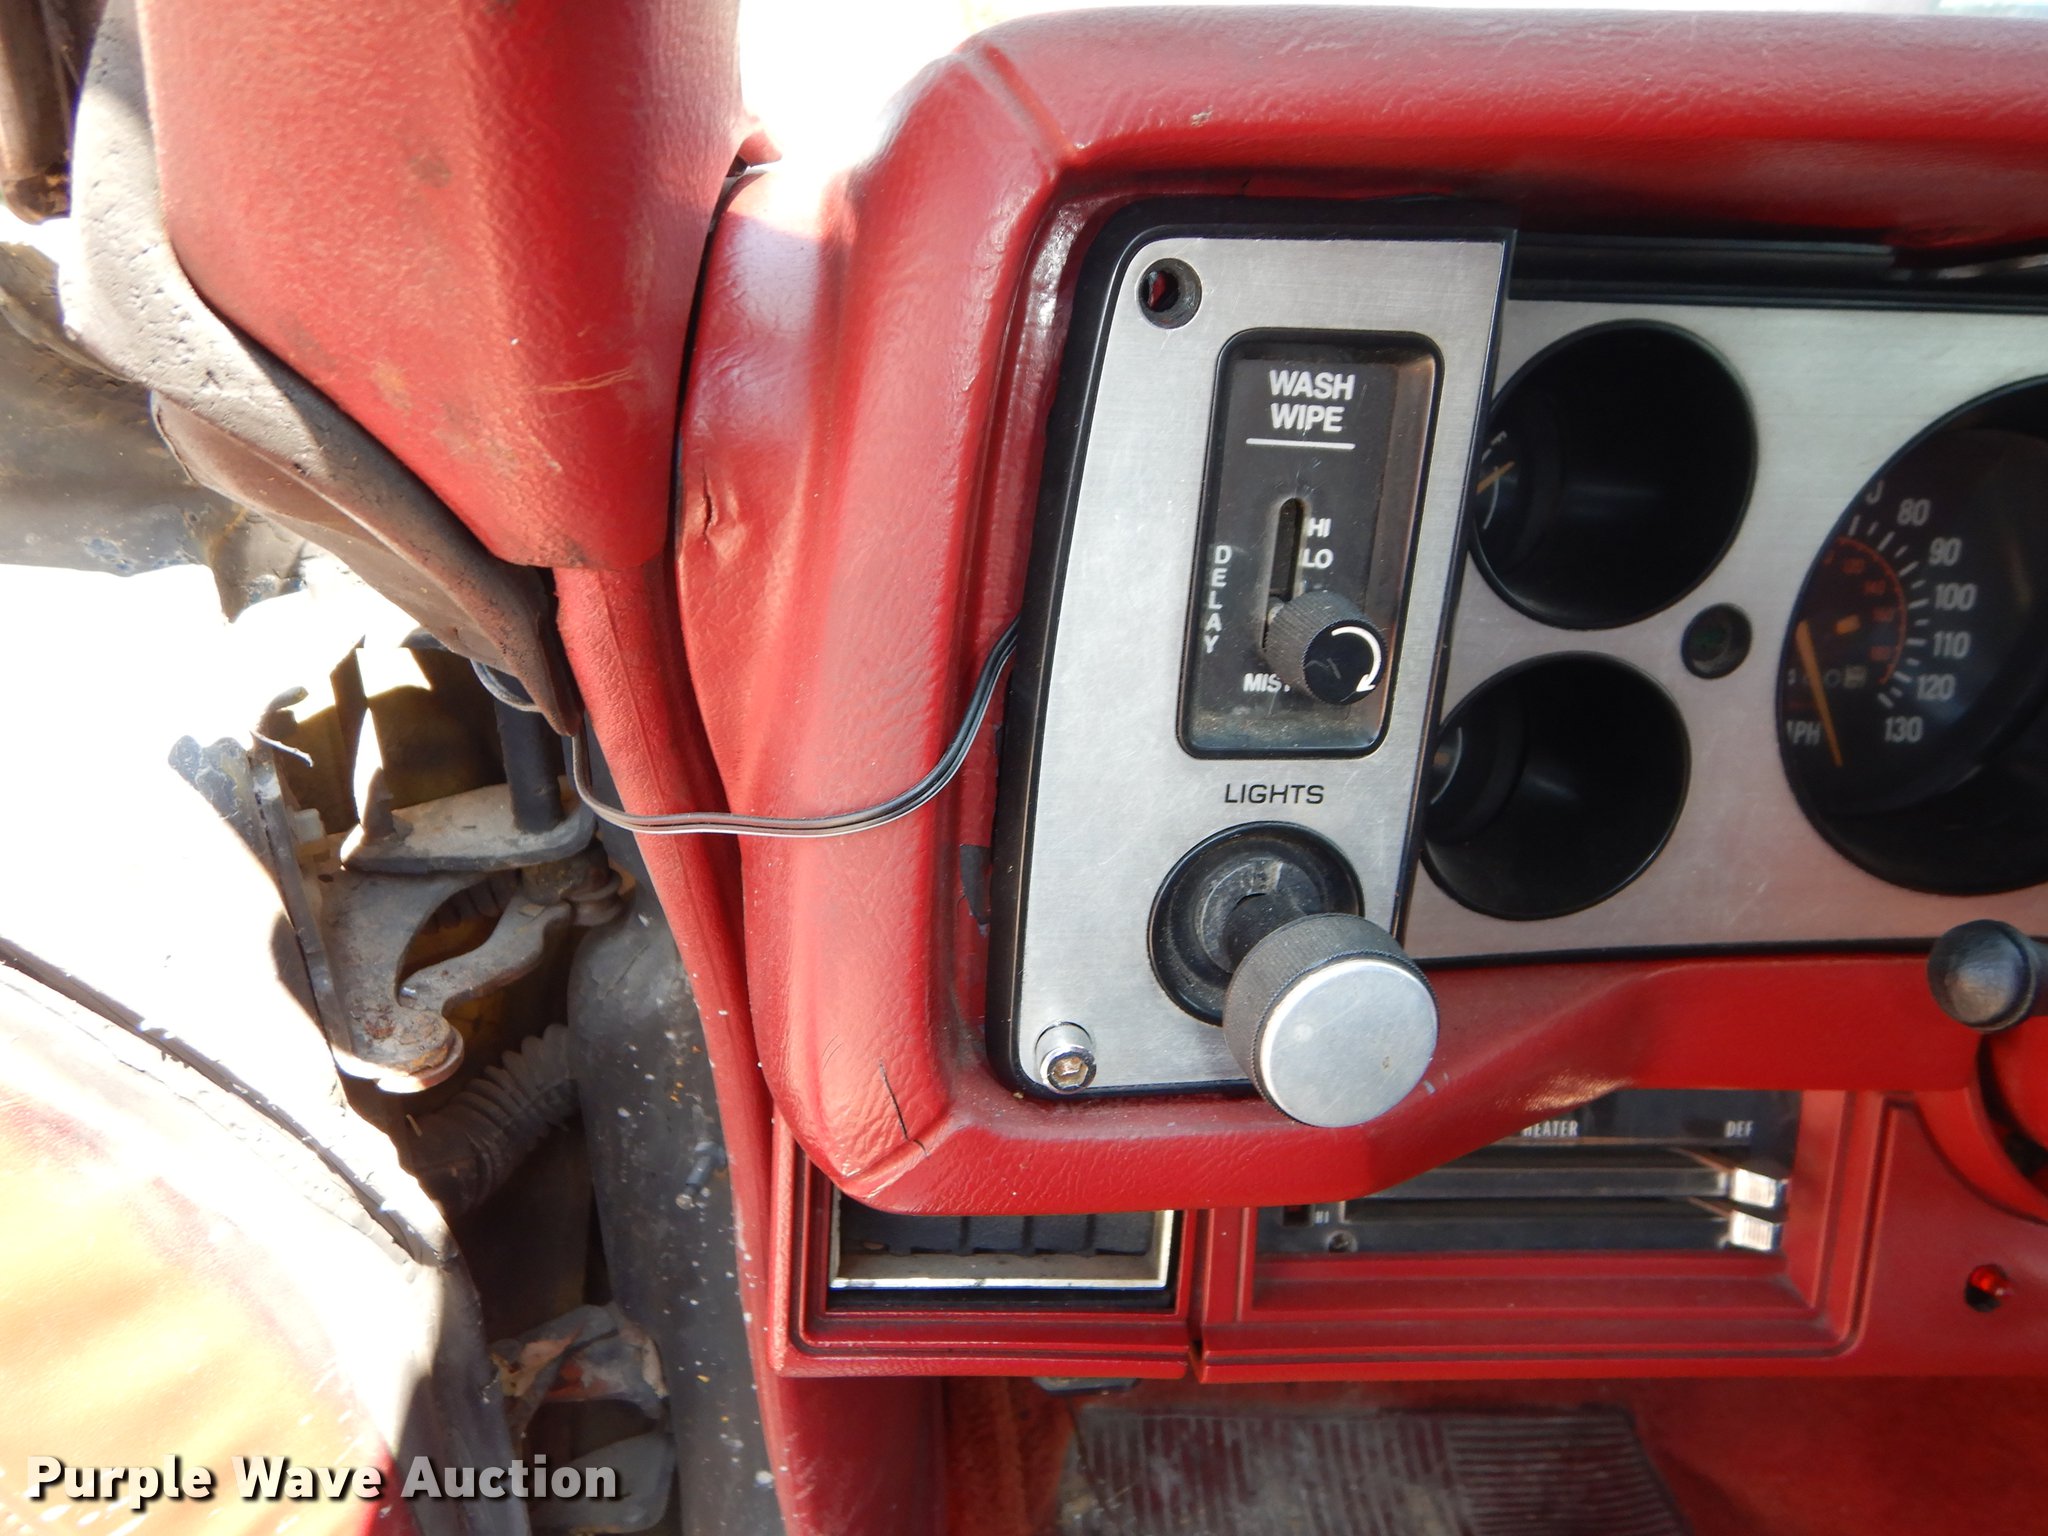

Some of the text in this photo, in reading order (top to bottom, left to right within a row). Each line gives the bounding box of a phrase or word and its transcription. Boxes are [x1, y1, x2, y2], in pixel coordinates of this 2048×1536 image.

[1270, 369, 1356, 401] WASH
[1271, 402, 1345, 433] WIPE
[1897, 498, 1931, 527] 80
[1307, 517, 1332, 538] HI
[1302, 548, 1334, 570] LO
[1928, 537, 1963, 567] 90
[1204, 544, 1232, 655] DELAY
[1934, 583, 1978, 611] 100
[1933, 631, 1971, 660] 110
[1917, 673, 1956, 701] 120
[1884, 715, 1924, 743] 130
[1224, 783, 1325, 805] LIGHTS
[1724, 1120, 1755, 1139] DEF
